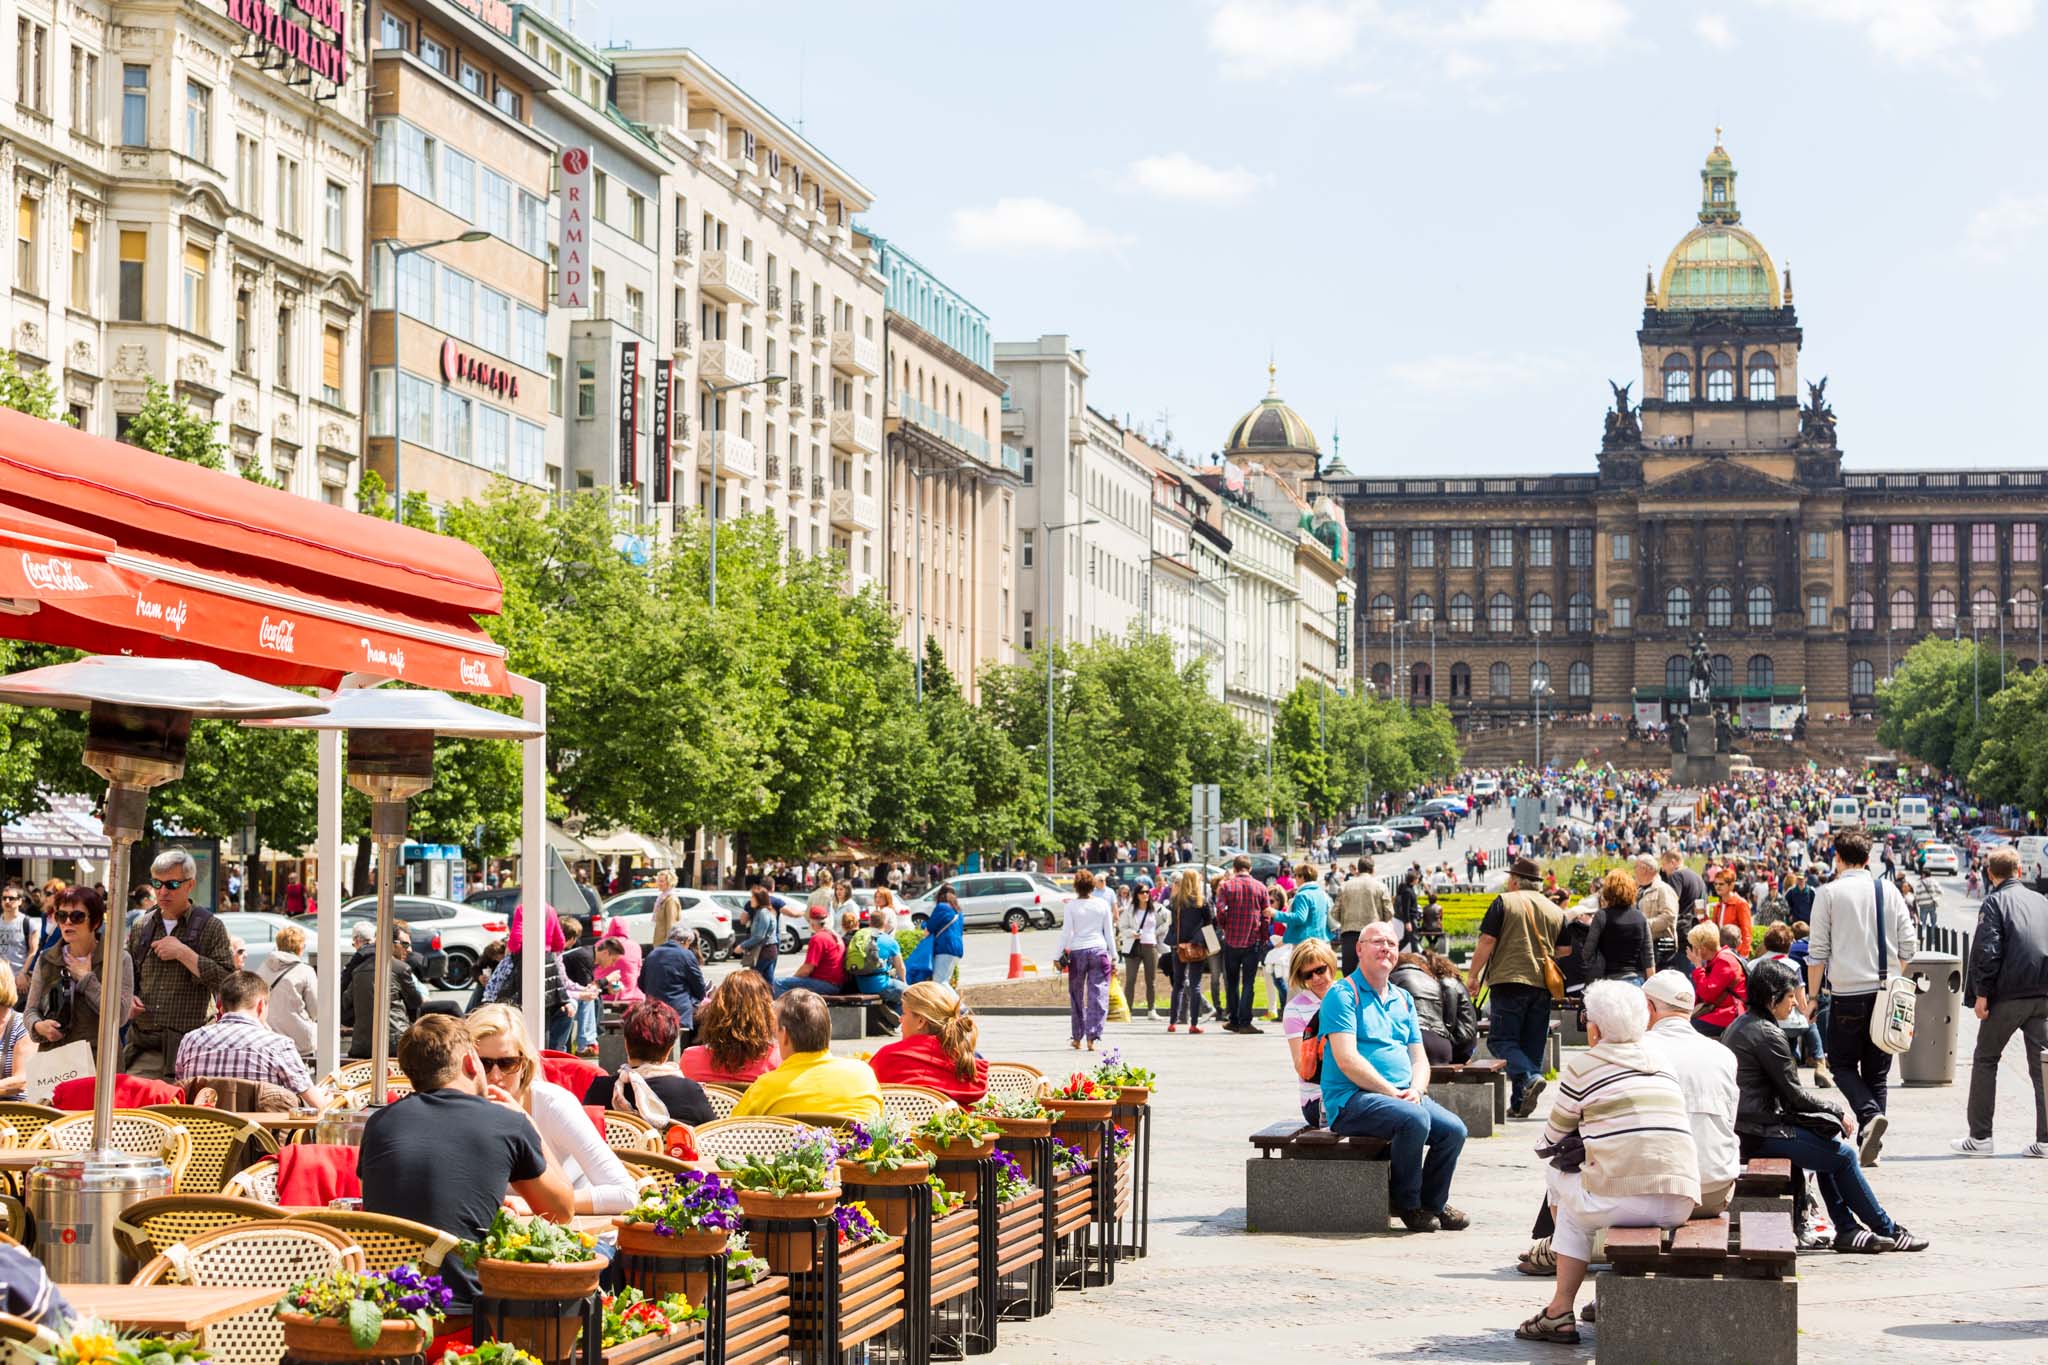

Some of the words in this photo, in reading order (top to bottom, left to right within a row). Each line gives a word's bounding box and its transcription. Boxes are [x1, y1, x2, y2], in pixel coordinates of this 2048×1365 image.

[228, 0, 342, 84] RESTAURANT
[296, 0, 341, 34] ECH
[566, 187, 582, 306] RAMADA
[457, 353, 520, 398] RAMADA
[621, 351, 636, 421] Elysee
[656, 368, 669, 436] Elysee
[165, 600, 187, 632] café
[37, 1070, 78, 1087] MANGO
